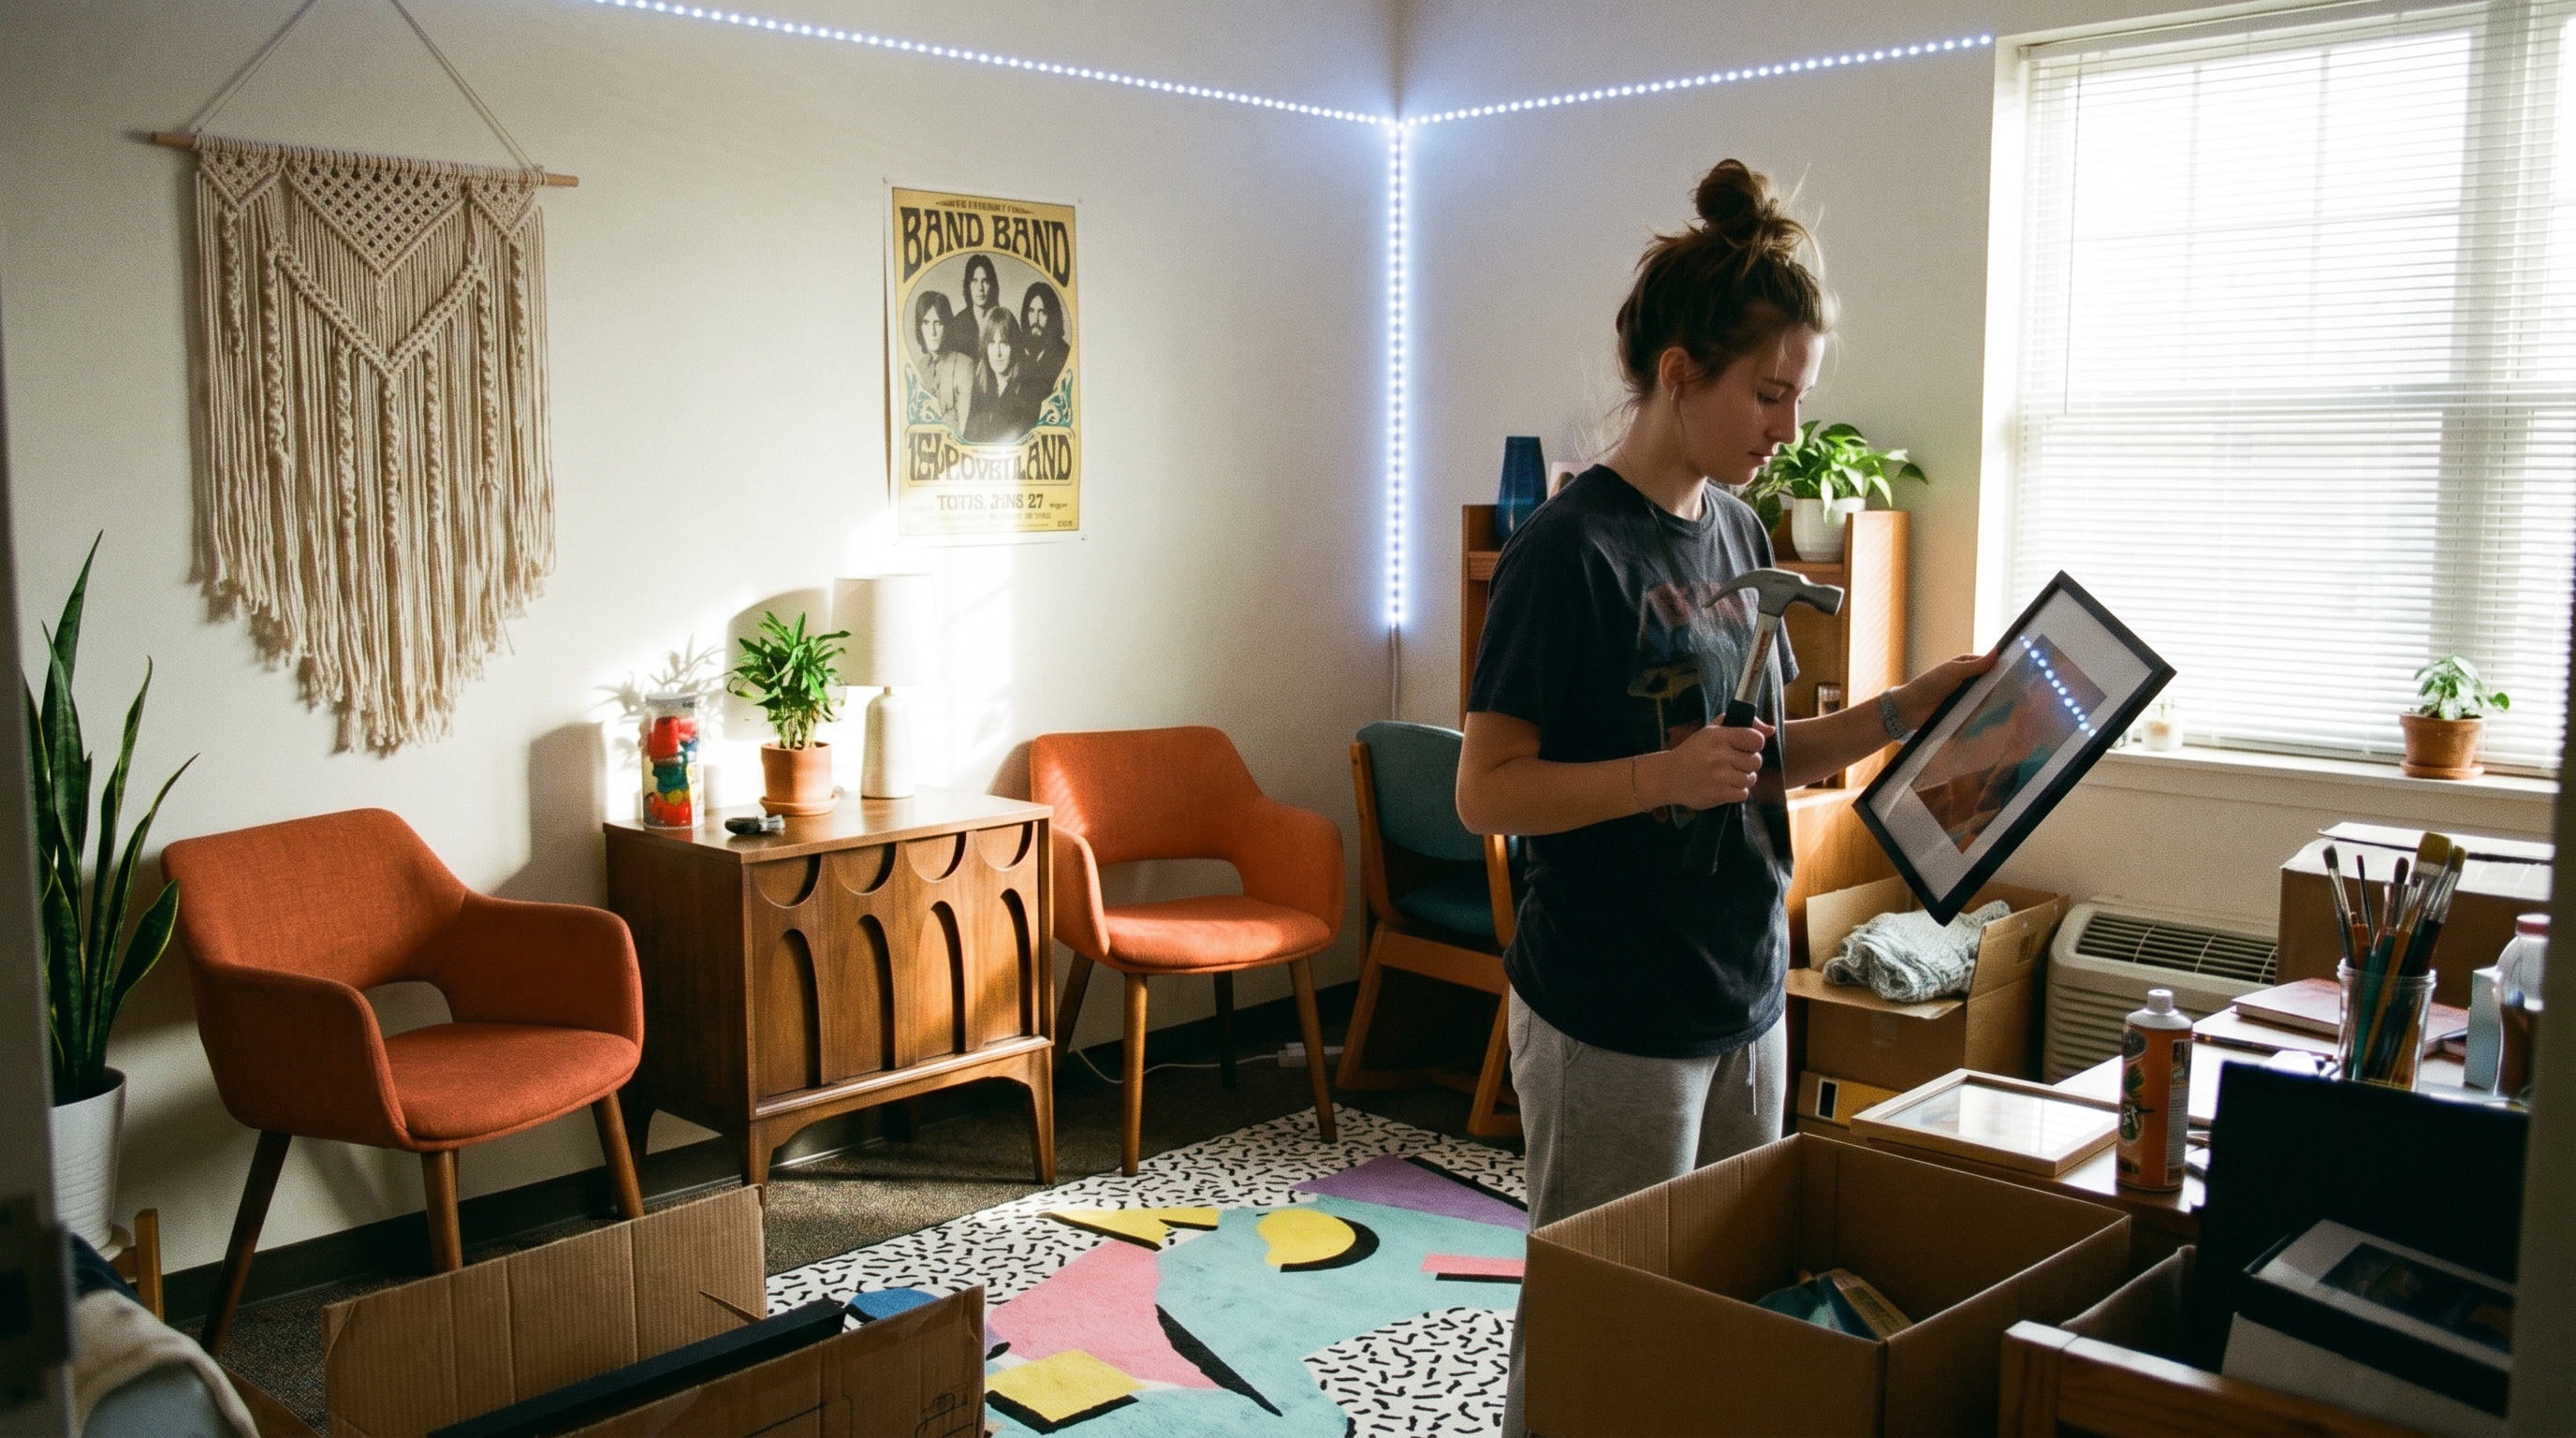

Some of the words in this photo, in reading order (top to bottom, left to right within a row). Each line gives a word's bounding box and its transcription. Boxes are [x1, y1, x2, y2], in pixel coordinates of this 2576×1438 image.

[900, 206, 985, 284] BAND
[992, 214, 1071, 287] BAND
[1028, 493, 1044, 509] 27
